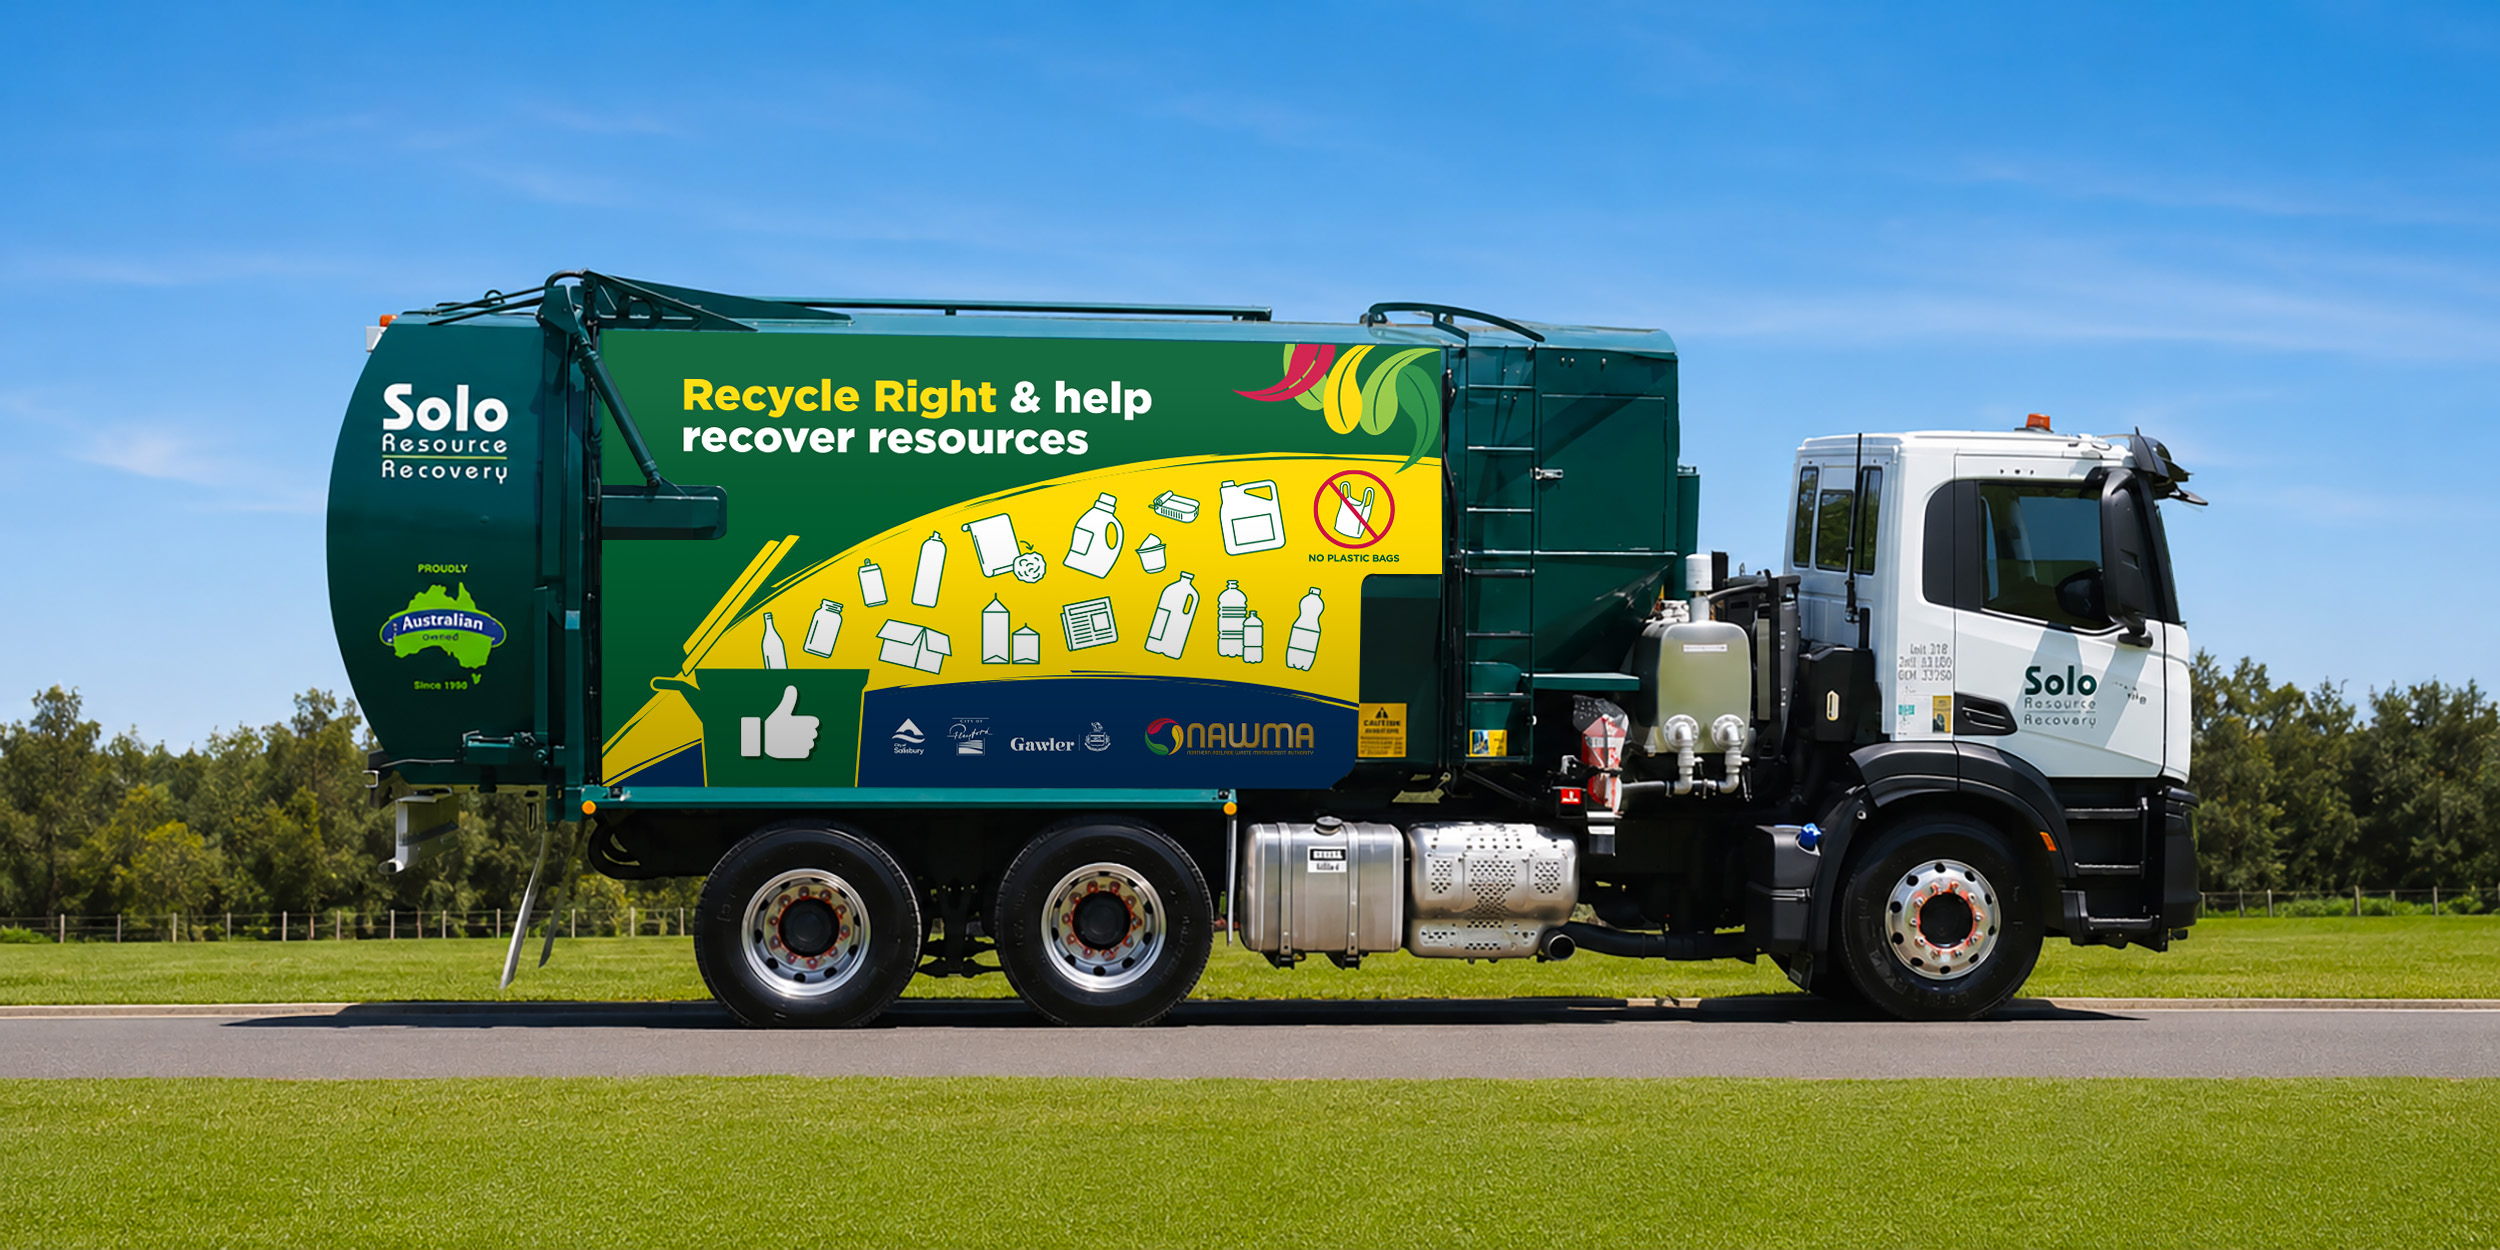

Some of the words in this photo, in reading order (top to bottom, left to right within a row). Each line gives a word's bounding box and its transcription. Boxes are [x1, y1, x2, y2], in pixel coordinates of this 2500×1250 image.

[383, 383, 509, 433] Solo
[683, 378, 860, 418] Recycle
[875, 379, 997, 420] Right
[1010, 380, 1041, 414] &
[1055, 380, 1153, 421] help
[382, 432, 508, 454] Resource
[683, 426, 856, 454] recover
[869, 427, 1089, 456] resources
[382, 459, 508, 485] Recovery
[417, 563, 469, 573] PROUDLY
[1308, 553, 1325, 563] NO
[1327, 553, 1370, 563] PLASTIC
[1372, 553, 1400, 563] BAGS
[402, 612, 484, 631] Australian
[413, 681, 442, 690] Since
[2024, 665, 2098, 696] Solo
[2024, 697, 2096, 710] Resource
[2024, 714, 2096, 729] Recovery
[1010, 737, 1075, 752] Gawler
[1187, 723, 1315, 748] NAWMA
